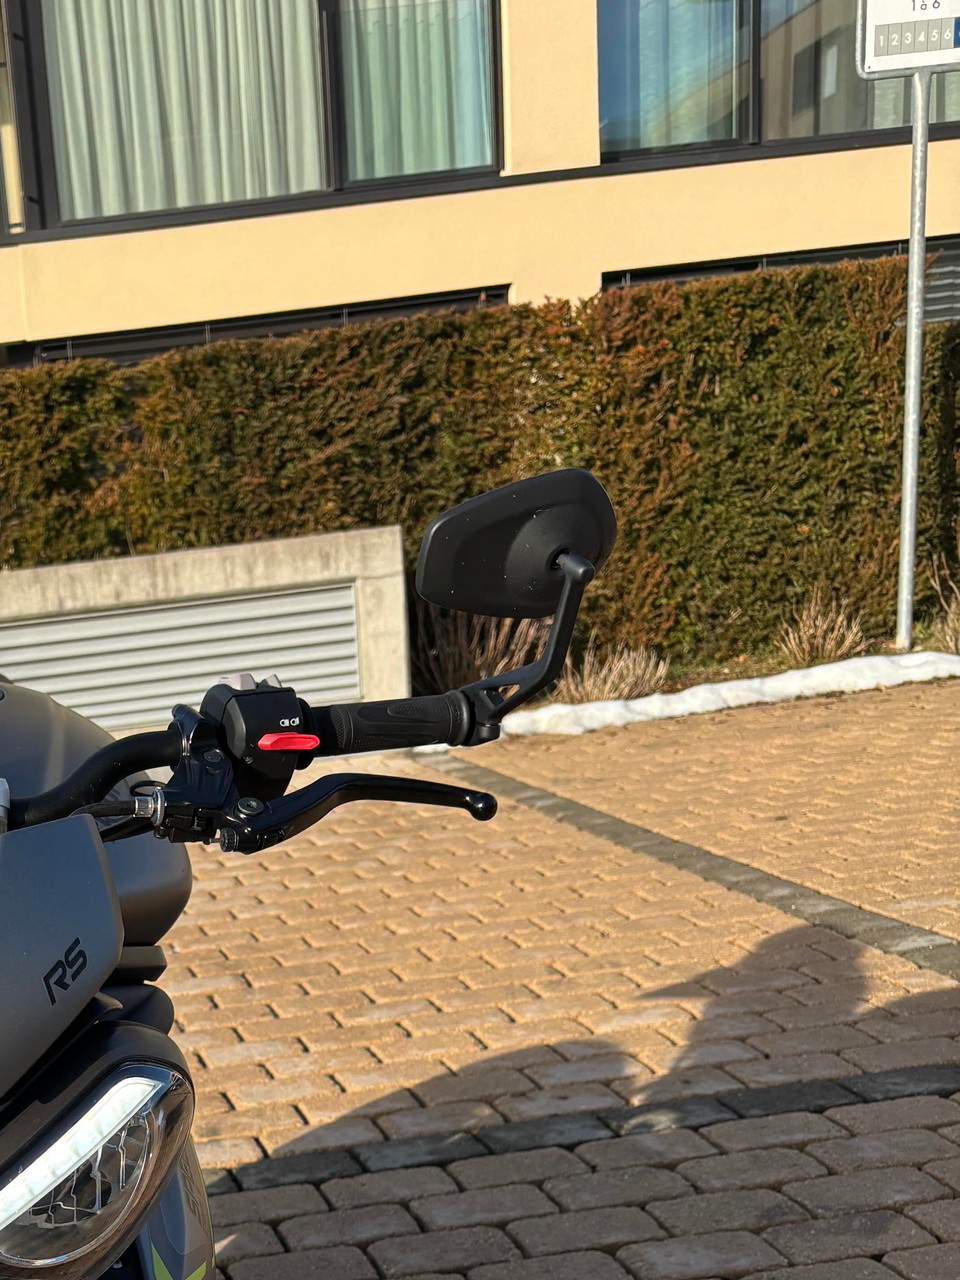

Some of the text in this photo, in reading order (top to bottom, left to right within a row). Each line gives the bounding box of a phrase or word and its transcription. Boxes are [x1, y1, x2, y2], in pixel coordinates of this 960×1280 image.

[879, 28, 952, 47] 1 2 3 4 5 6
[42, 936, 88, 1007] RS
